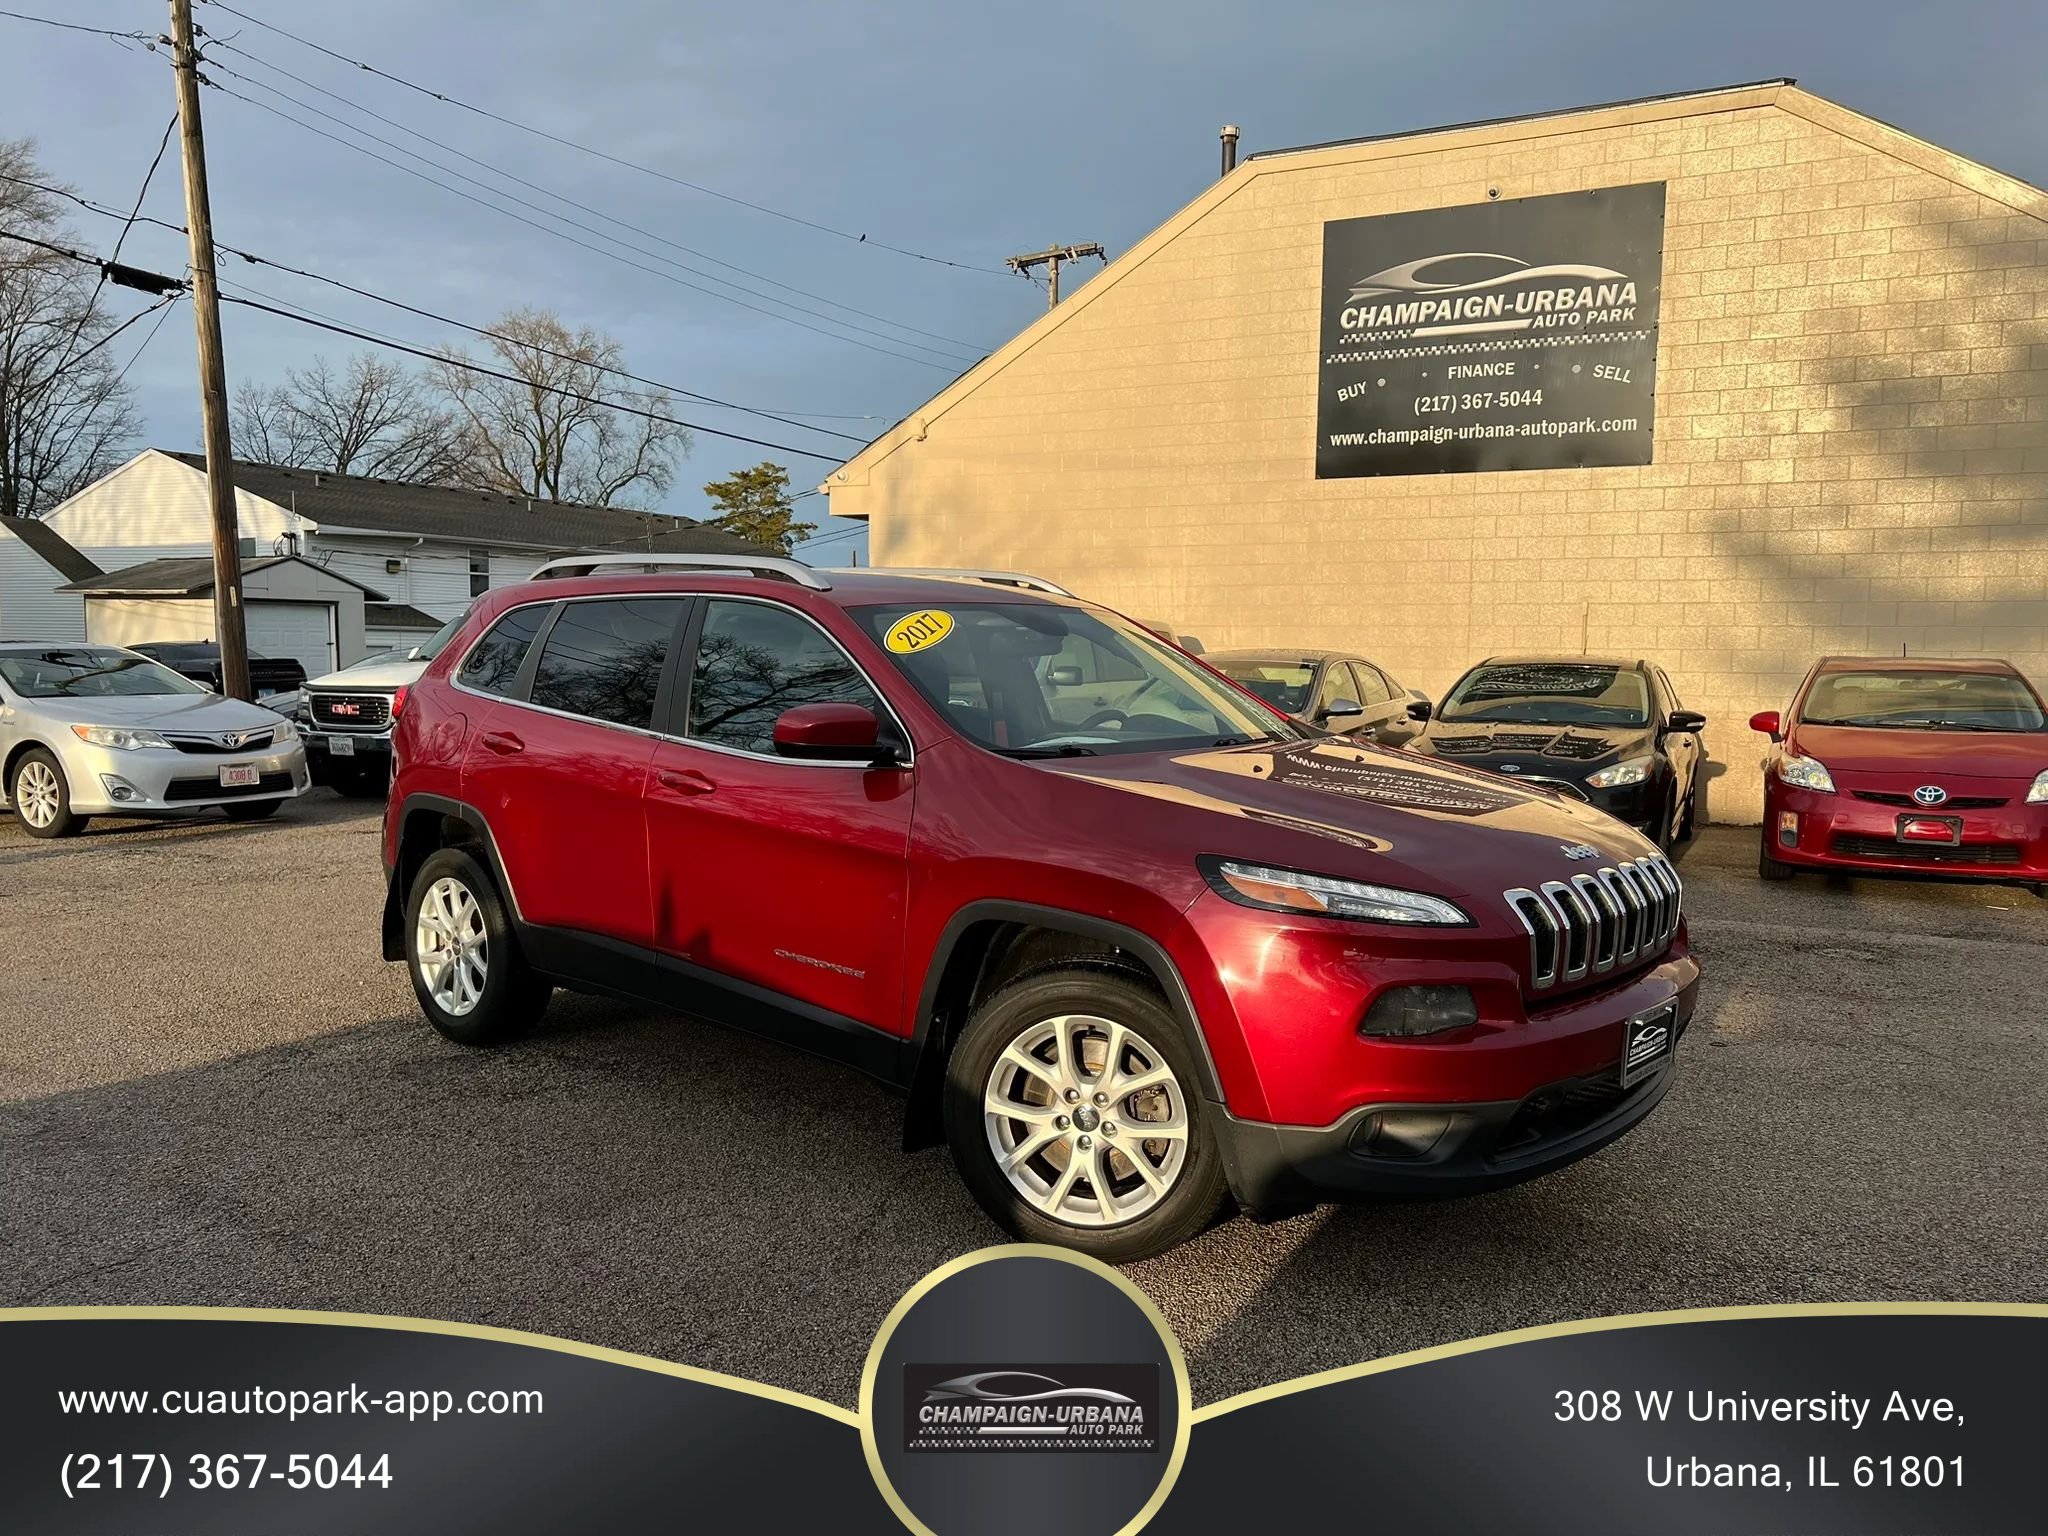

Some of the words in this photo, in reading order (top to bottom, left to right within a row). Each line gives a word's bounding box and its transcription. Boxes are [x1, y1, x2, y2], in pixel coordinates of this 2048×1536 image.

[1339, 281, 1638, 330] CHAMPAIGN-URBANA
[1531, 312, 1581, 329] AUTO
[1585, 306, 1637, 325] PARK
[1336, 382, 1368, 403] BUY
[1448, 362, 1515, 380] FINANCE
[1592, 364, 1632, 384] SELL
[1414, 394, 1457, 416] (217)
[1461, 389, 1543, 410] 367-5044
[1330, 416, 1638, 447] www.champaign-urbana-autopark.com
[896, 613, 944, 649] 2017
[332, 704, 360, 715] GMC
[1560, 844, 1600, 860] Jeep
[774, 948, 865, 979] CHEROKEE
